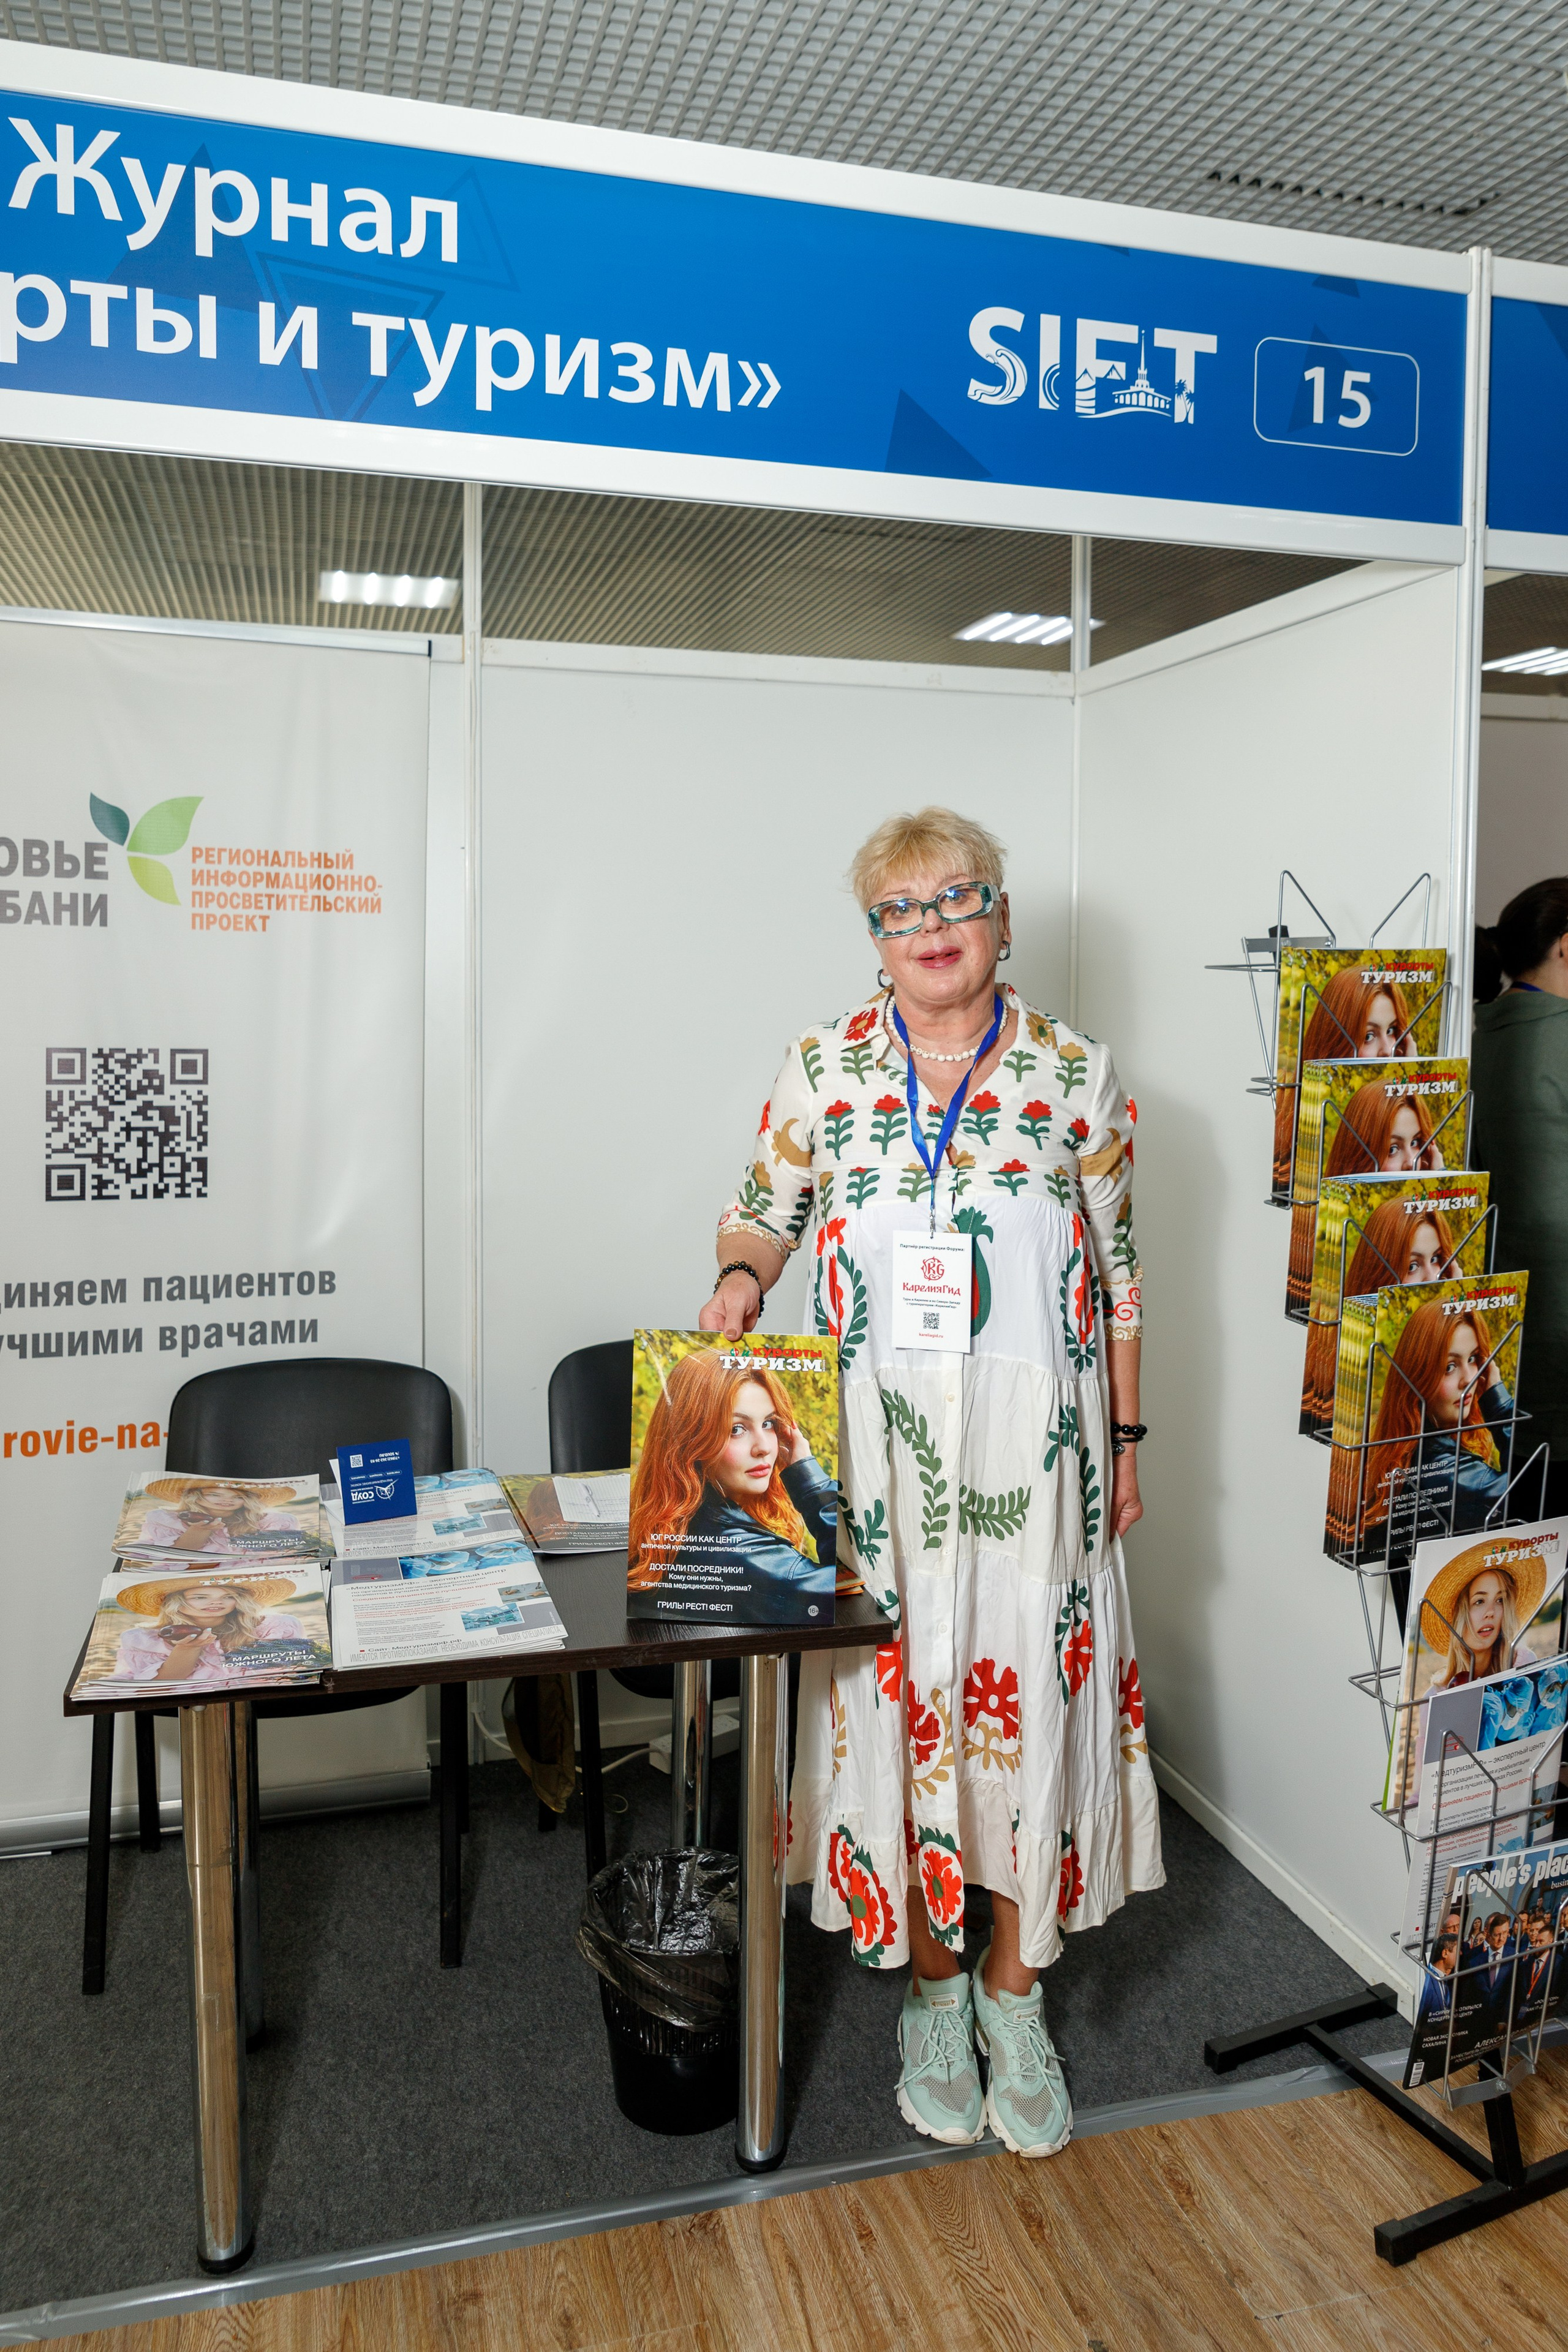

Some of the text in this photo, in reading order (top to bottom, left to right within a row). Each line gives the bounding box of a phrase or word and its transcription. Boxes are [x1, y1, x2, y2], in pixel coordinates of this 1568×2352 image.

[8, 117, 459, 263] Журнал
[258, 301, 318, 370] и
[352, 311, 782, 412] туризм»
[968, 306, 1218, 424] SIFT
[1304, 366, 1372, 429] 15
[191, 846, 354, 870] РЕГИОНАЛЬНЫЙ
[191, 869, 383, 892] ИНФОРМАЦИОННО-
[0, 890, 108, 928] БАНИ
[191, 891, 382, 914] ПРОСВЕТИТЕЛЬСКИЙ
[190, 913, 270, 933] ПРОЕКТ
[1385, 962, 1434, 972] курорты
[1361, 971, 1433, 984] ТУРИЗМ
[1409, 1072, 1457, 1084] курорты
[1384, 1080, 1456, 1097] ТУРИЗМ
[1428, 1187, 1477, 1200] курорты
[1403, 1196, 1477, 1214] ТУРИЗМ
[0, 1270, 337, 1314] иняем пациентов
[903, 1282, 960, 1296] КарелияГид
[1467, 1286, 1517, 1300] курорты
[1442, 1294, 1515, 1316] ТУРИЗМ
[0, 1319, 318, 1359] чшими врачами
[753, 1348, 822, 1359] курорты
[720, 1355, 822, 1372] ТУРИЗМ
[351, 1489, 374, 1501] СОУД
[1409, 1486, 1448, 1498] ПОРЕДНИКИ!
[664, 1534, 697, 1542] РОССИИ
[1509, 1532, 1559, 1550] курорты
[1483, 1540, 1560, 1567] ТУРИЗМ
[669, 1573, 686, 1581] Кому
[687, 1565, 744, 1574] ПОСРЕДНИКИ!
[658, 1601, 685, 1610] ГРИЛЬ!
[350, 1627, 563, 1662] ИМЕЮТСЯ ПРОТИВОПОКАЗАНИЯ. НЕОБХОДИМА КОНСУЛЬТАЦИЯ СПЕЦИАЛИСТА.
[222, 1657, 281, 1668] ЮЖНОГО
[232, 1650, 306, 1662] МАРШРУТЫ
[1493, 1747, 1528, 1763] экспертный
[1529, 1741, 1545, 1752] центр
[1432, 1790, 1491, 1810] Сединяем пациентов
[1532, 1847, 1568, 1888] plac
[1459, 2003, 1482, 2011] ОТКРЫЛСЯ
[1439, 2030, 1468, 2039] ЭКООМИКА
[1422, 2040, 1447, 2048] САХАЛИНА
